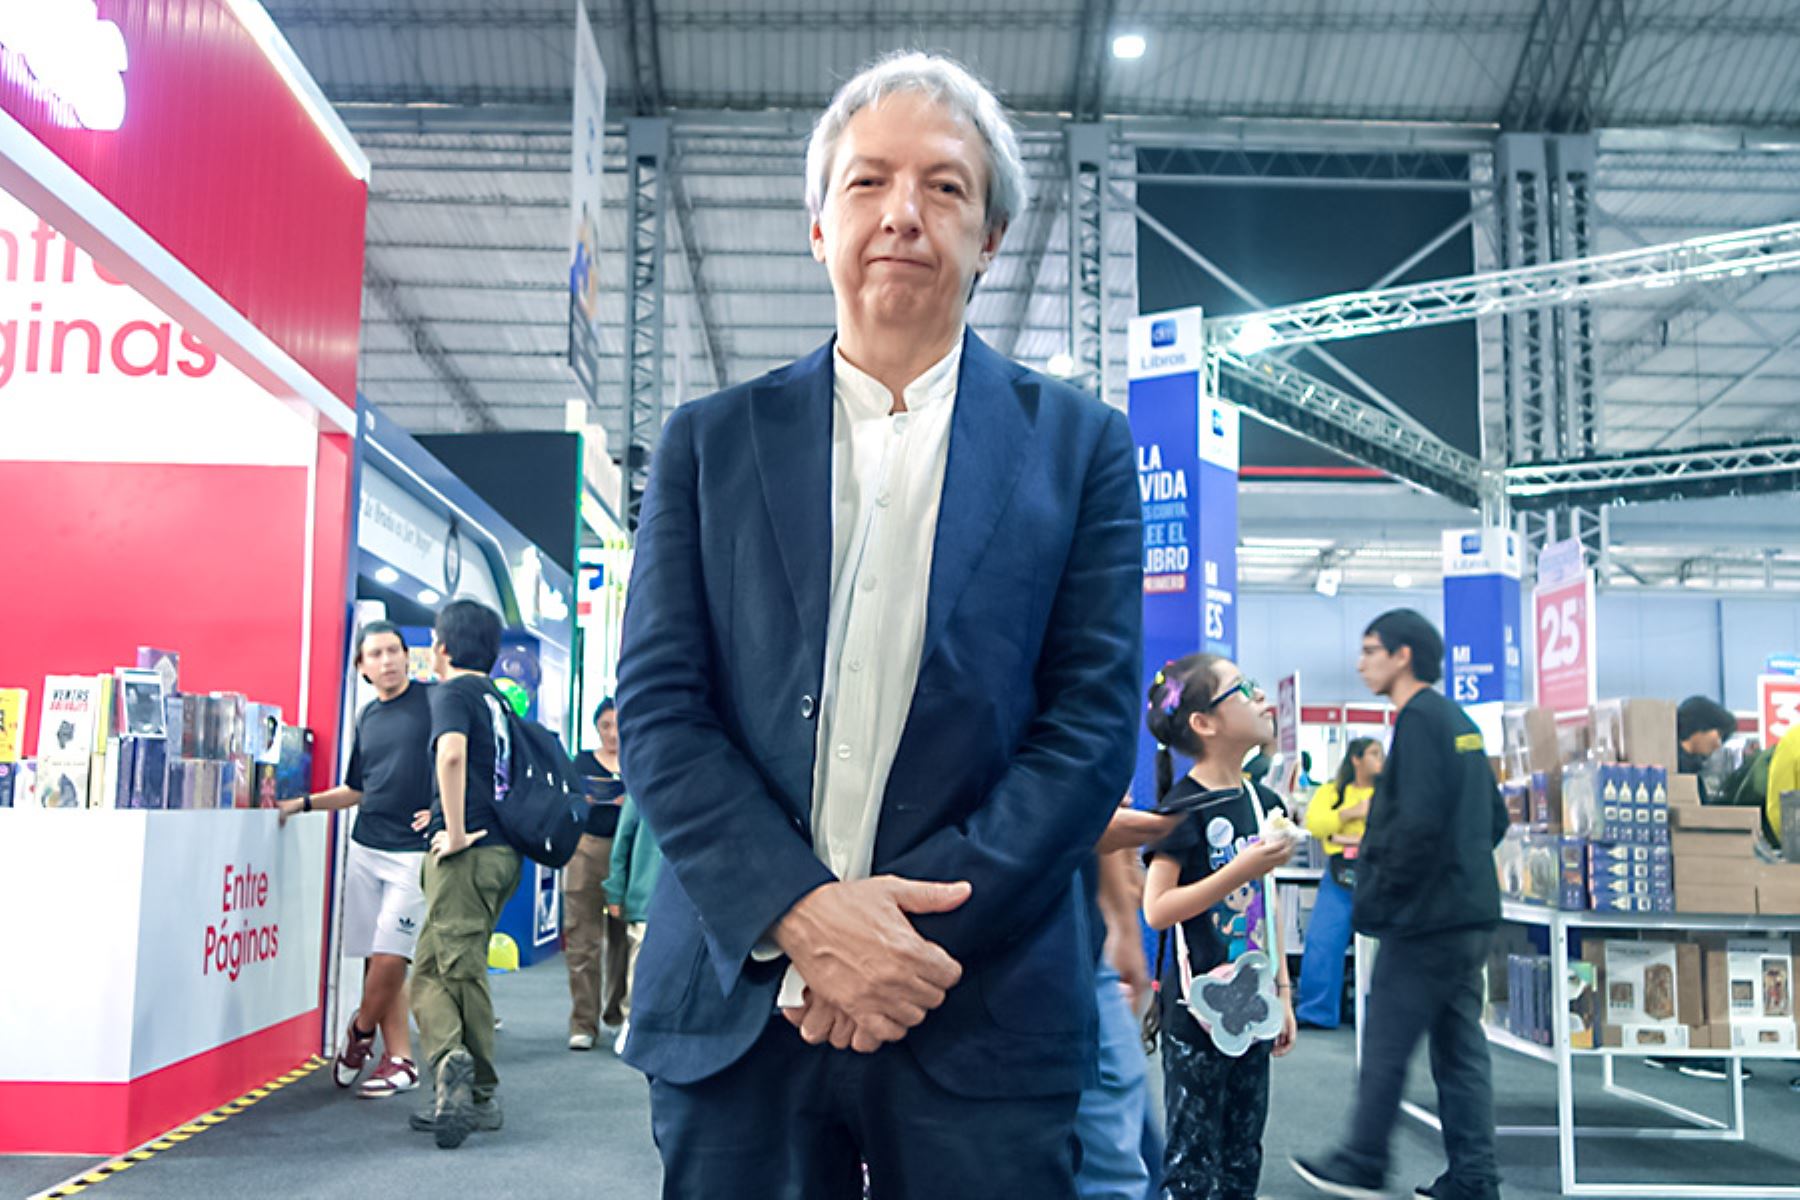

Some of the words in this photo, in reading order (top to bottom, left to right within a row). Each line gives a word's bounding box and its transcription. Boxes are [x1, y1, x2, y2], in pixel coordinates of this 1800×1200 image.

[1141, 353, 1186, 370] Libros
[1138, 445, 1162, 471] LA
[1138, 469, 1187, 501] VIDA
[1143, 523, 1164, 547] EE
[1168, 521, 1187, 544] EL
[1143, 545, 1189, 573] IBRO
[1205, 601, 1223, 639] ES
[1541, 598, 1580, 670] 25
[1453, 645, 1471, 663] MI
[1454, 675, 1479, 700] ES
[222, 863, 268, 912] Entre
[203, 918, 278, 982] Páginas
